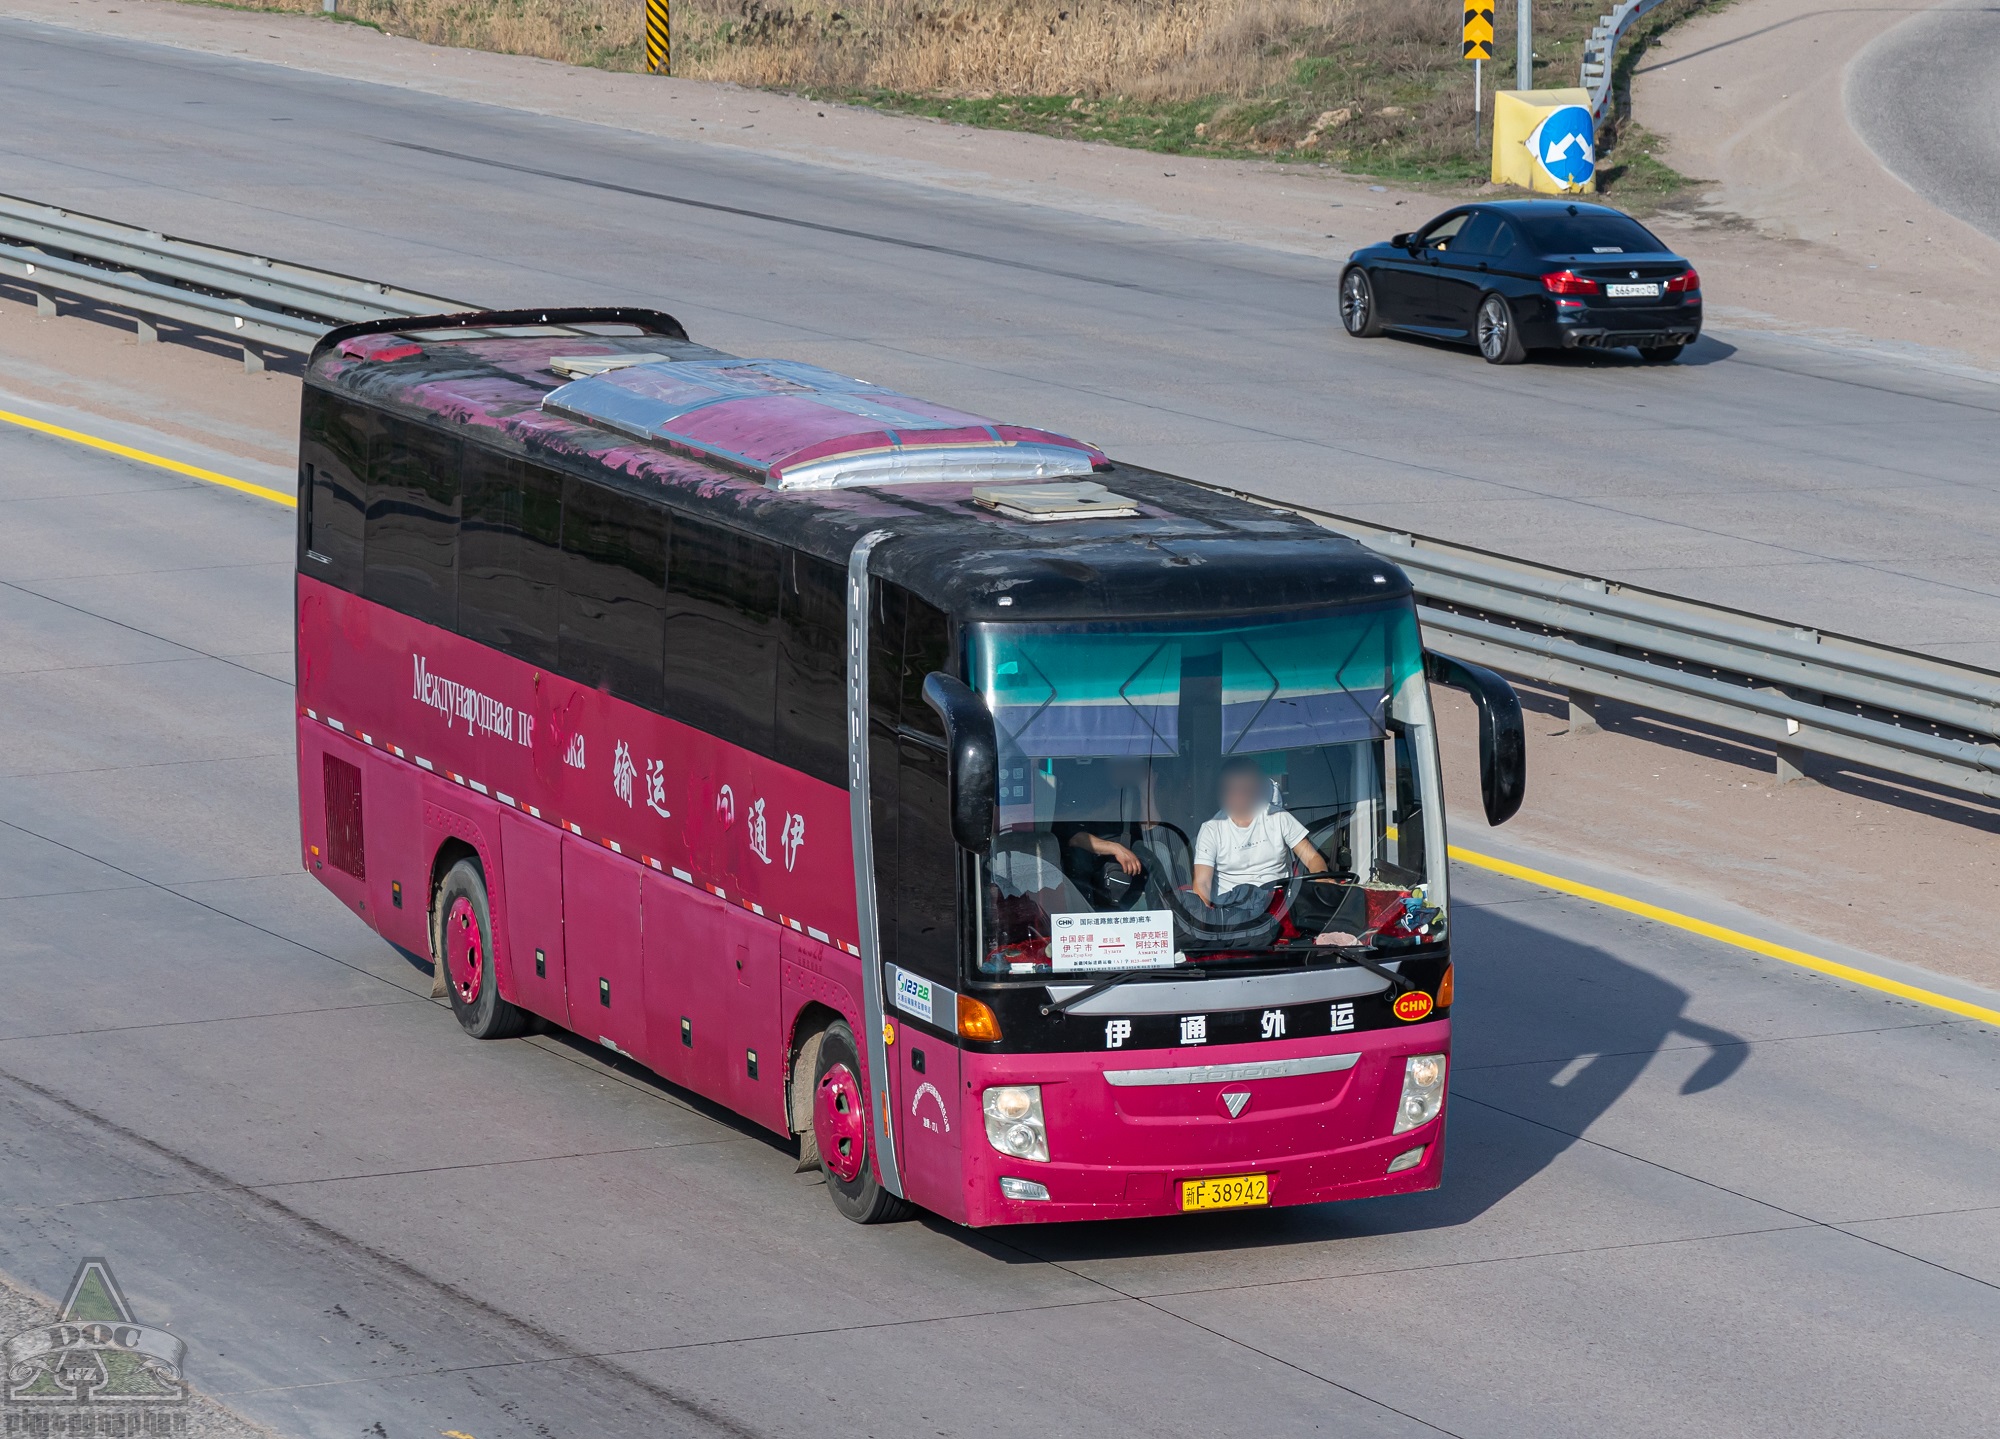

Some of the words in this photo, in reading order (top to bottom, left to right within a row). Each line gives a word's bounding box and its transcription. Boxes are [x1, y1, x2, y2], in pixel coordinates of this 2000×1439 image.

[413, 653, 513, 738] Международная
[1060, 934, 1094, 943] 中国新疆
[1133, 930, 1169, 939] 哈萨克斯坦
[1063, 943, 1093, 953] 伊宁市
[1135, 939, 1169, 949] 阿拉木图
[904, 978, 929, 1001] 12328
[1400, 999, 1428, 1013] CHN
[1189, 1064, 1287, 1084] FOTON
